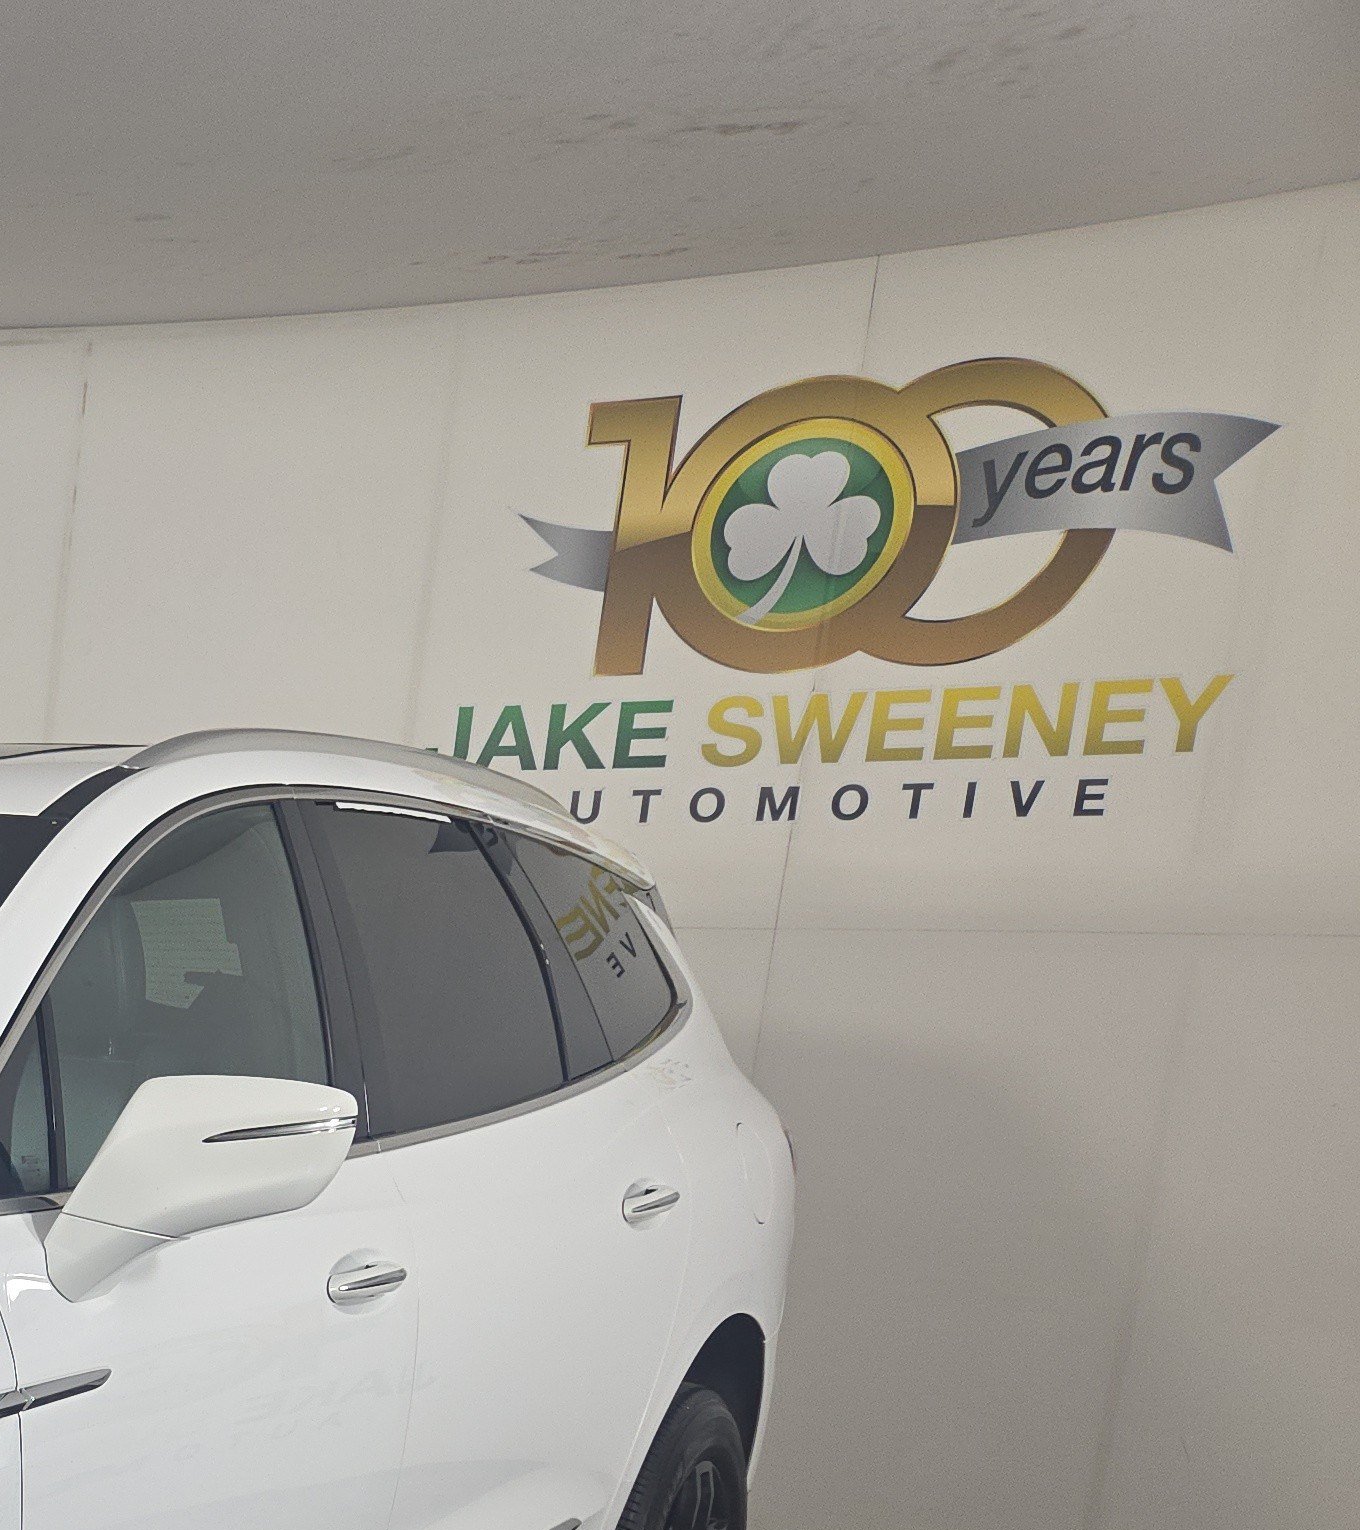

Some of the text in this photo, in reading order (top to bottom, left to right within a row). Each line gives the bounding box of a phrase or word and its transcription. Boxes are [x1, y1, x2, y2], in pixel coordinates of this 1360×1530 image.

[586, 356, 1203, 677] 100 years
[700, 674, 1235, 767] SWEENEY
[569, 778, 1110, 824] UTOMOTIVE
